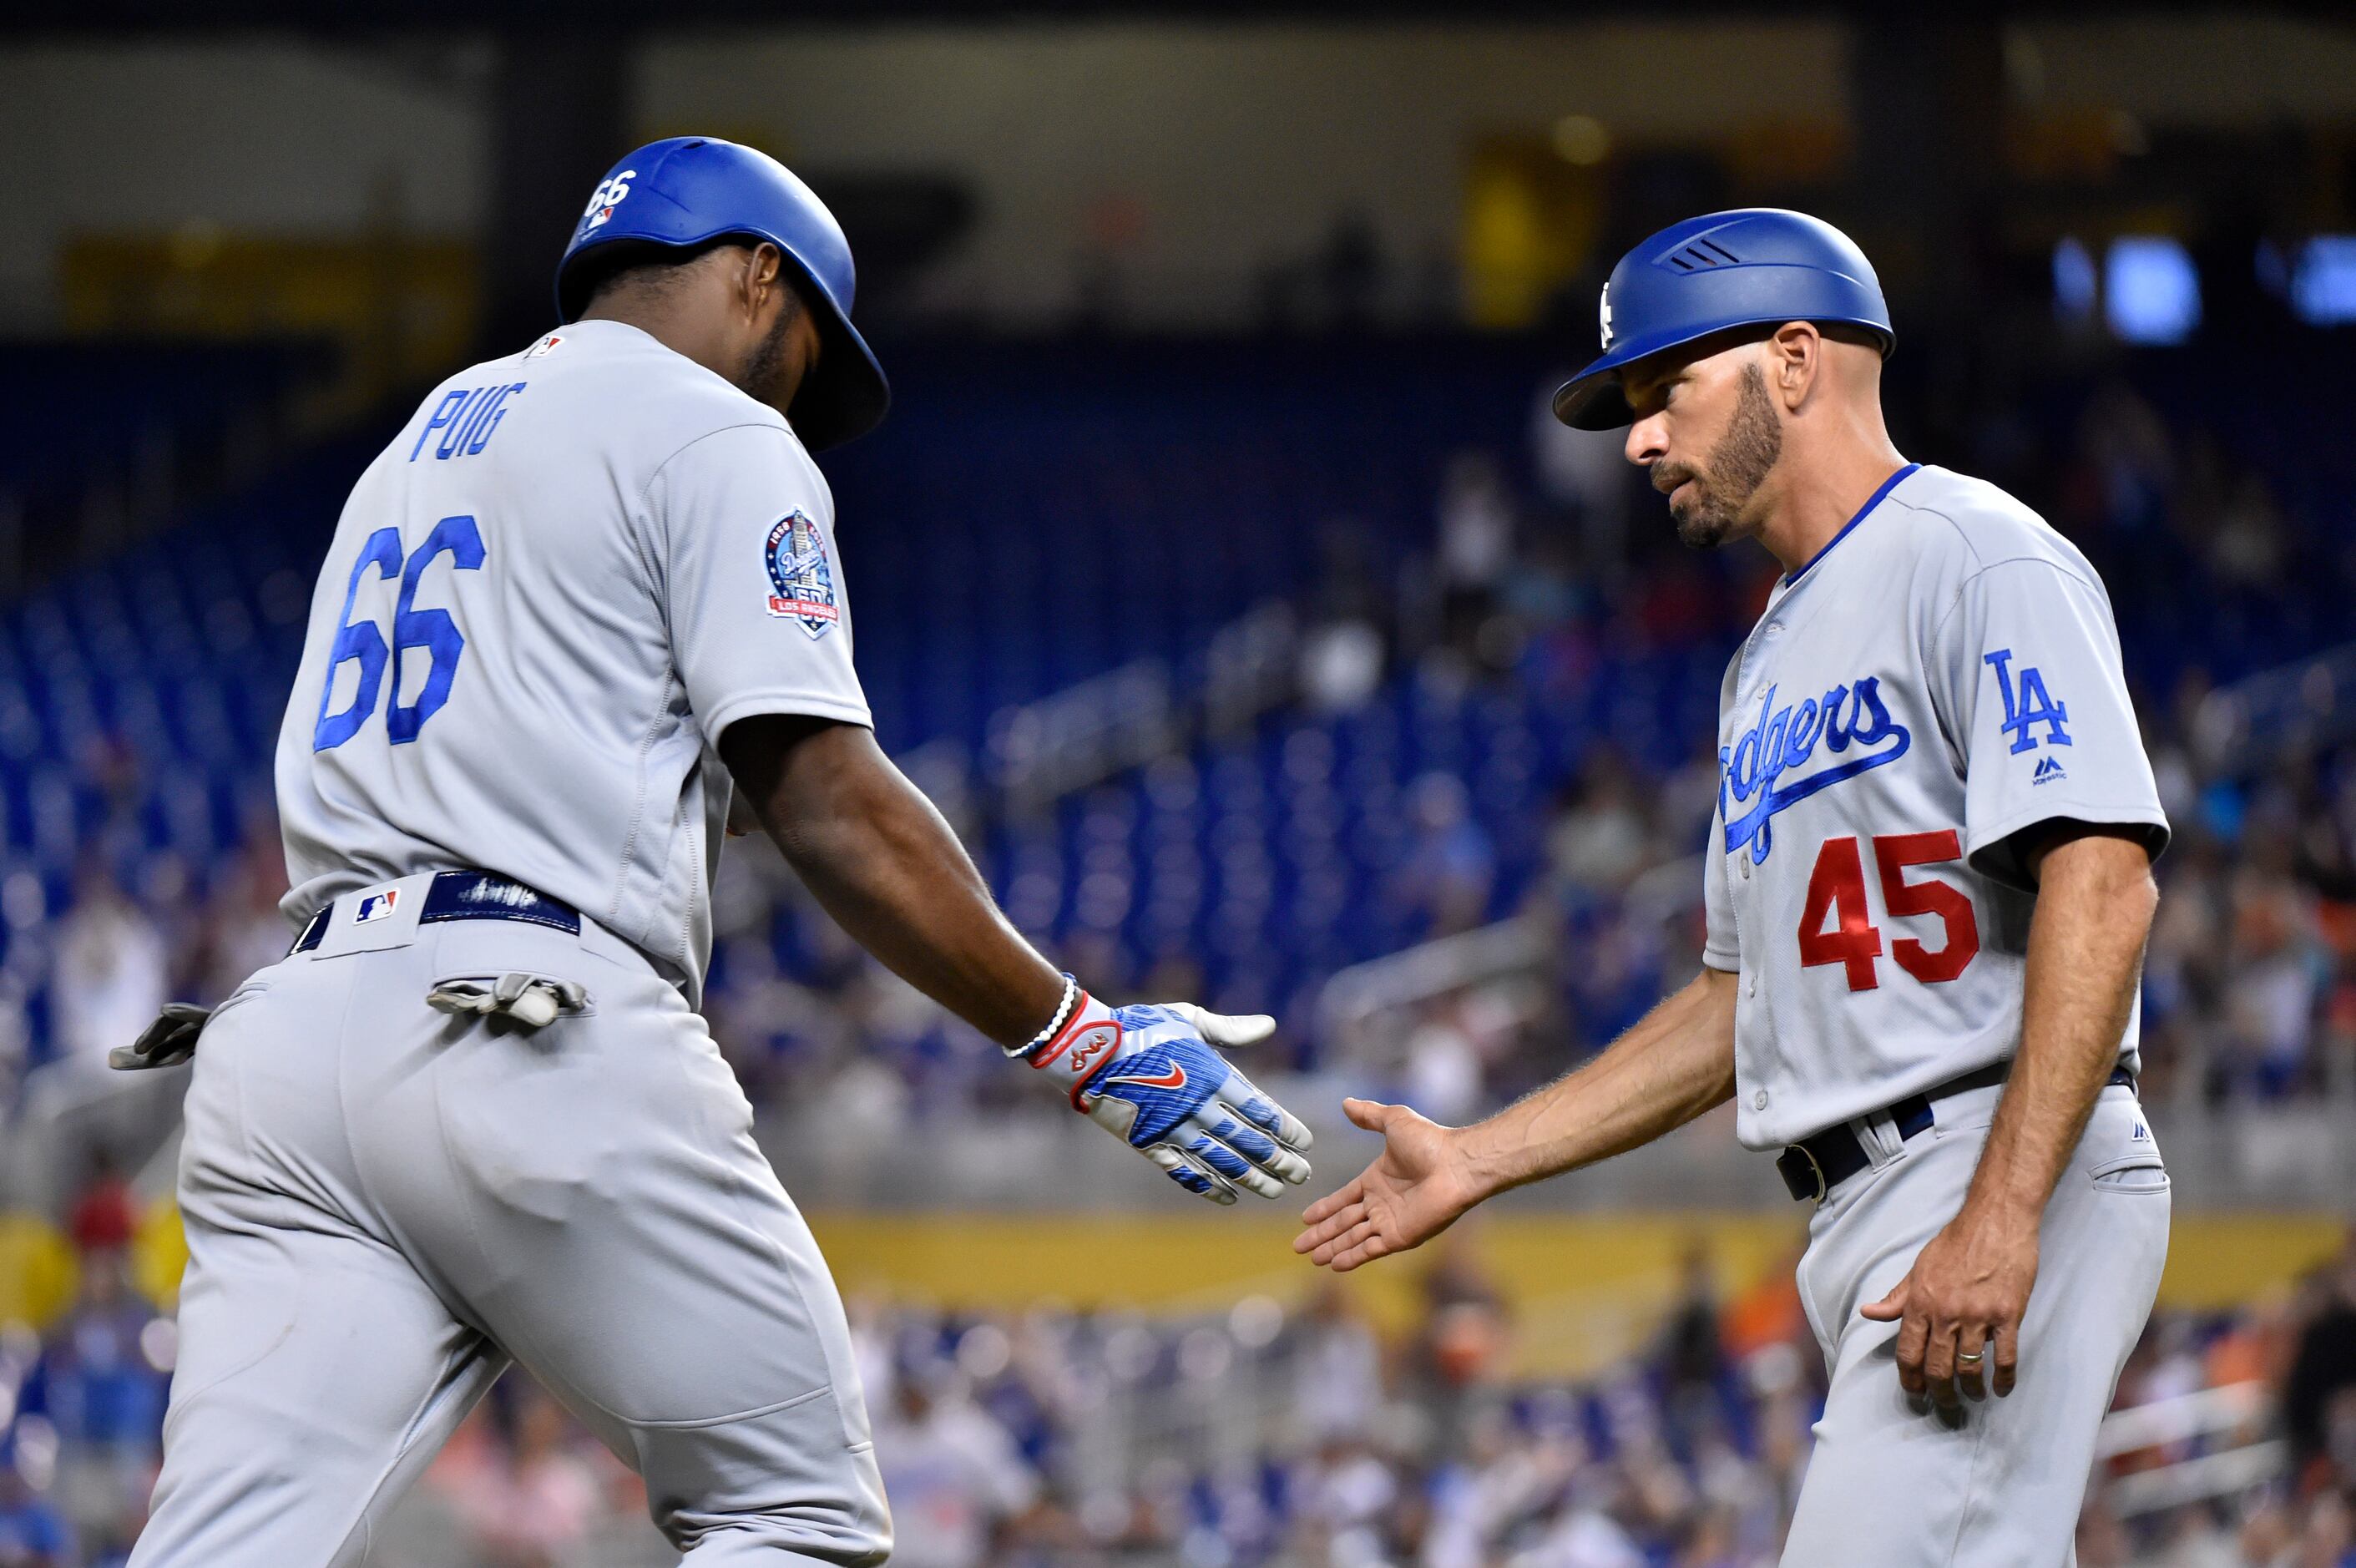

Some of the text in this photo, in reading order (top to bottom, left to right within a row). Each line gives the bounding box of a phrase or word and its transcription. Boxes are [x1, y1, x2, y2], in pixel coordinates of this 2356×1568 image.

[584, 169, 637, 217] 66
[409, 381, 528, 463] PUIG
[313, 514, 487, 755] 66
[778, 601, 799, 612] LOS
[1984, 648, 2072, 756] LA
[1797, 827, 1980, 993] 45
